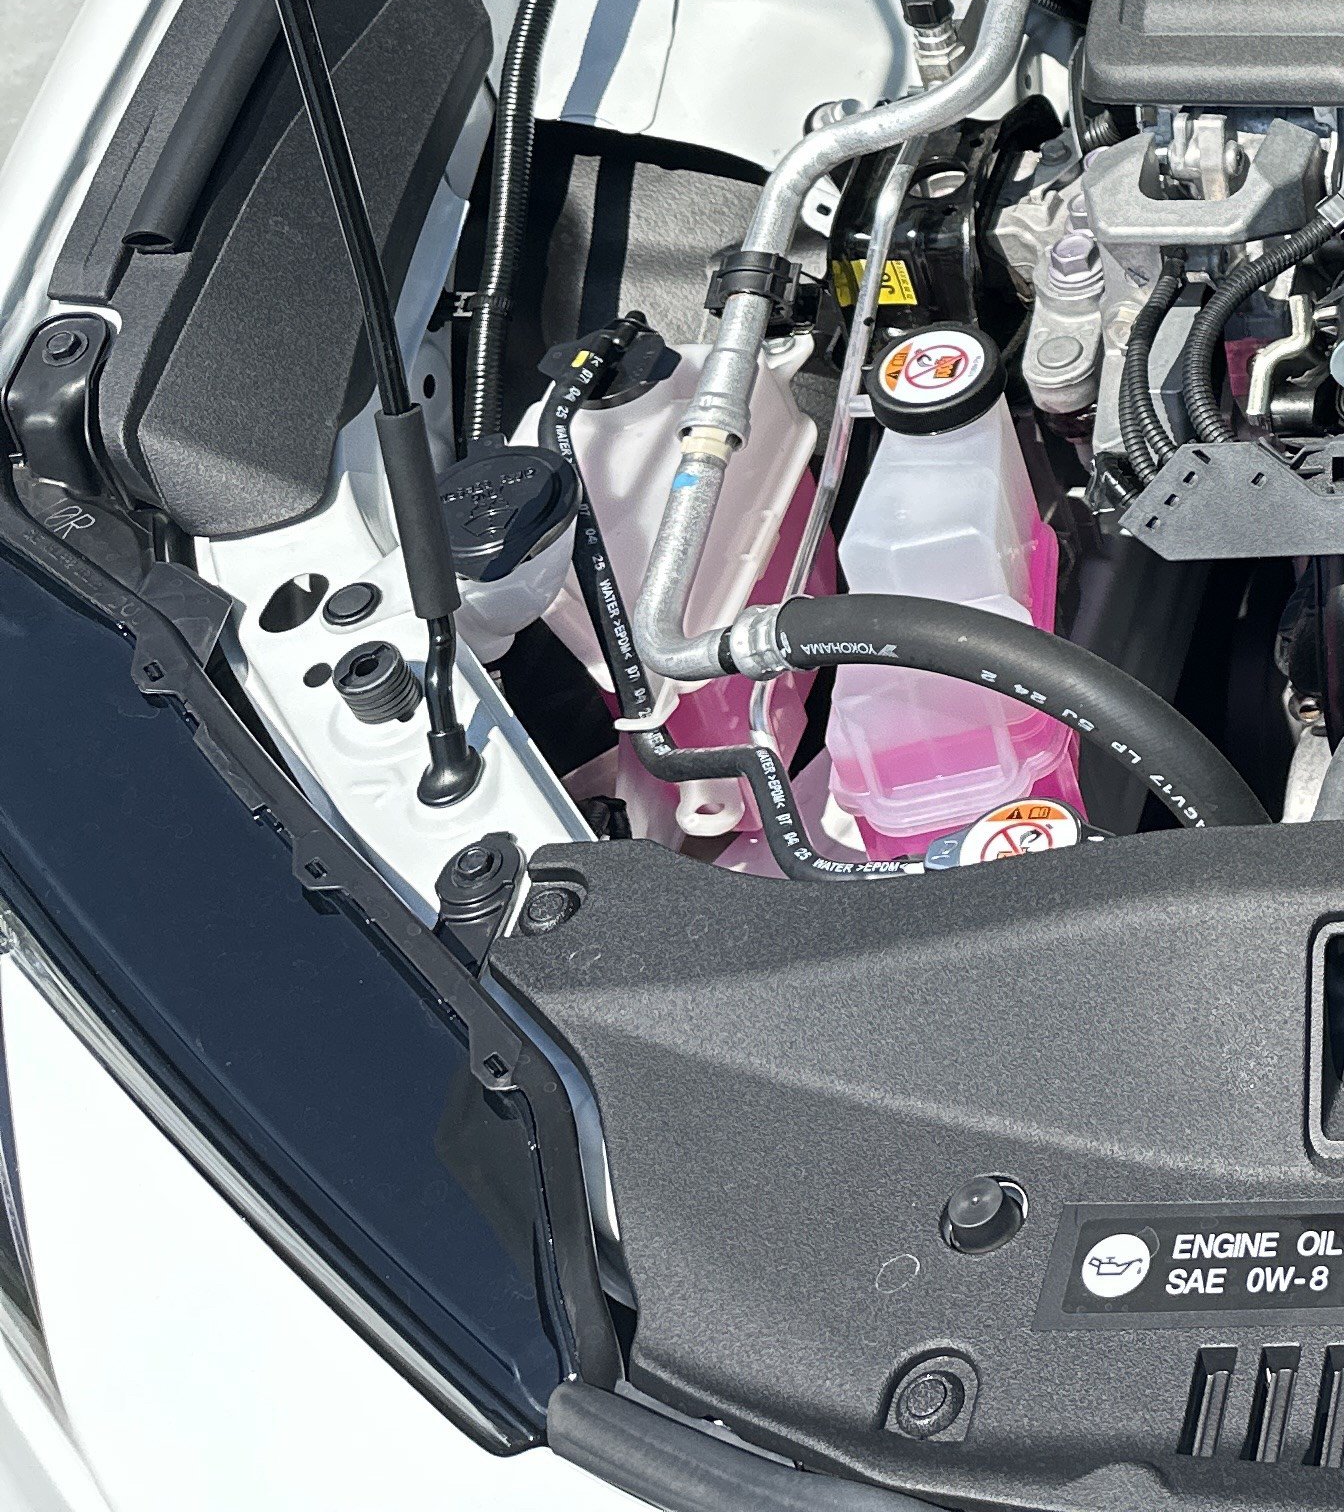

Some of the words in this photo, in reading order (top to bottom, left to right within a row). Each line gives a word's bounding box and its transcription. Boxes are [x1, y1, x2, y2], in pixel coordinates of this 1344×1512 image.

[555, 406, 569, 419] 25
[555, 424, 573, 459] WATER
[591, 555, 606, 571] 25
[599, 578, 621, 620] WATER
[800, 641, 878, 656] YOKOHAMA
[1013, 683, 1047, 705] 24
[1111, 741, 1142, 764] LP
[755, 749, 776, 776] WATER
[793, 847, 812, 861] 25
[812, 857, 854, 873] WATER
[1171, 1231, 1280, 1260] ENGINE
[1296, 1230, 1343, 1256] OIL
[1164, 1267, 1227, 1295] SAE
[1246, 1265, 1330, 1293] 0W-8
